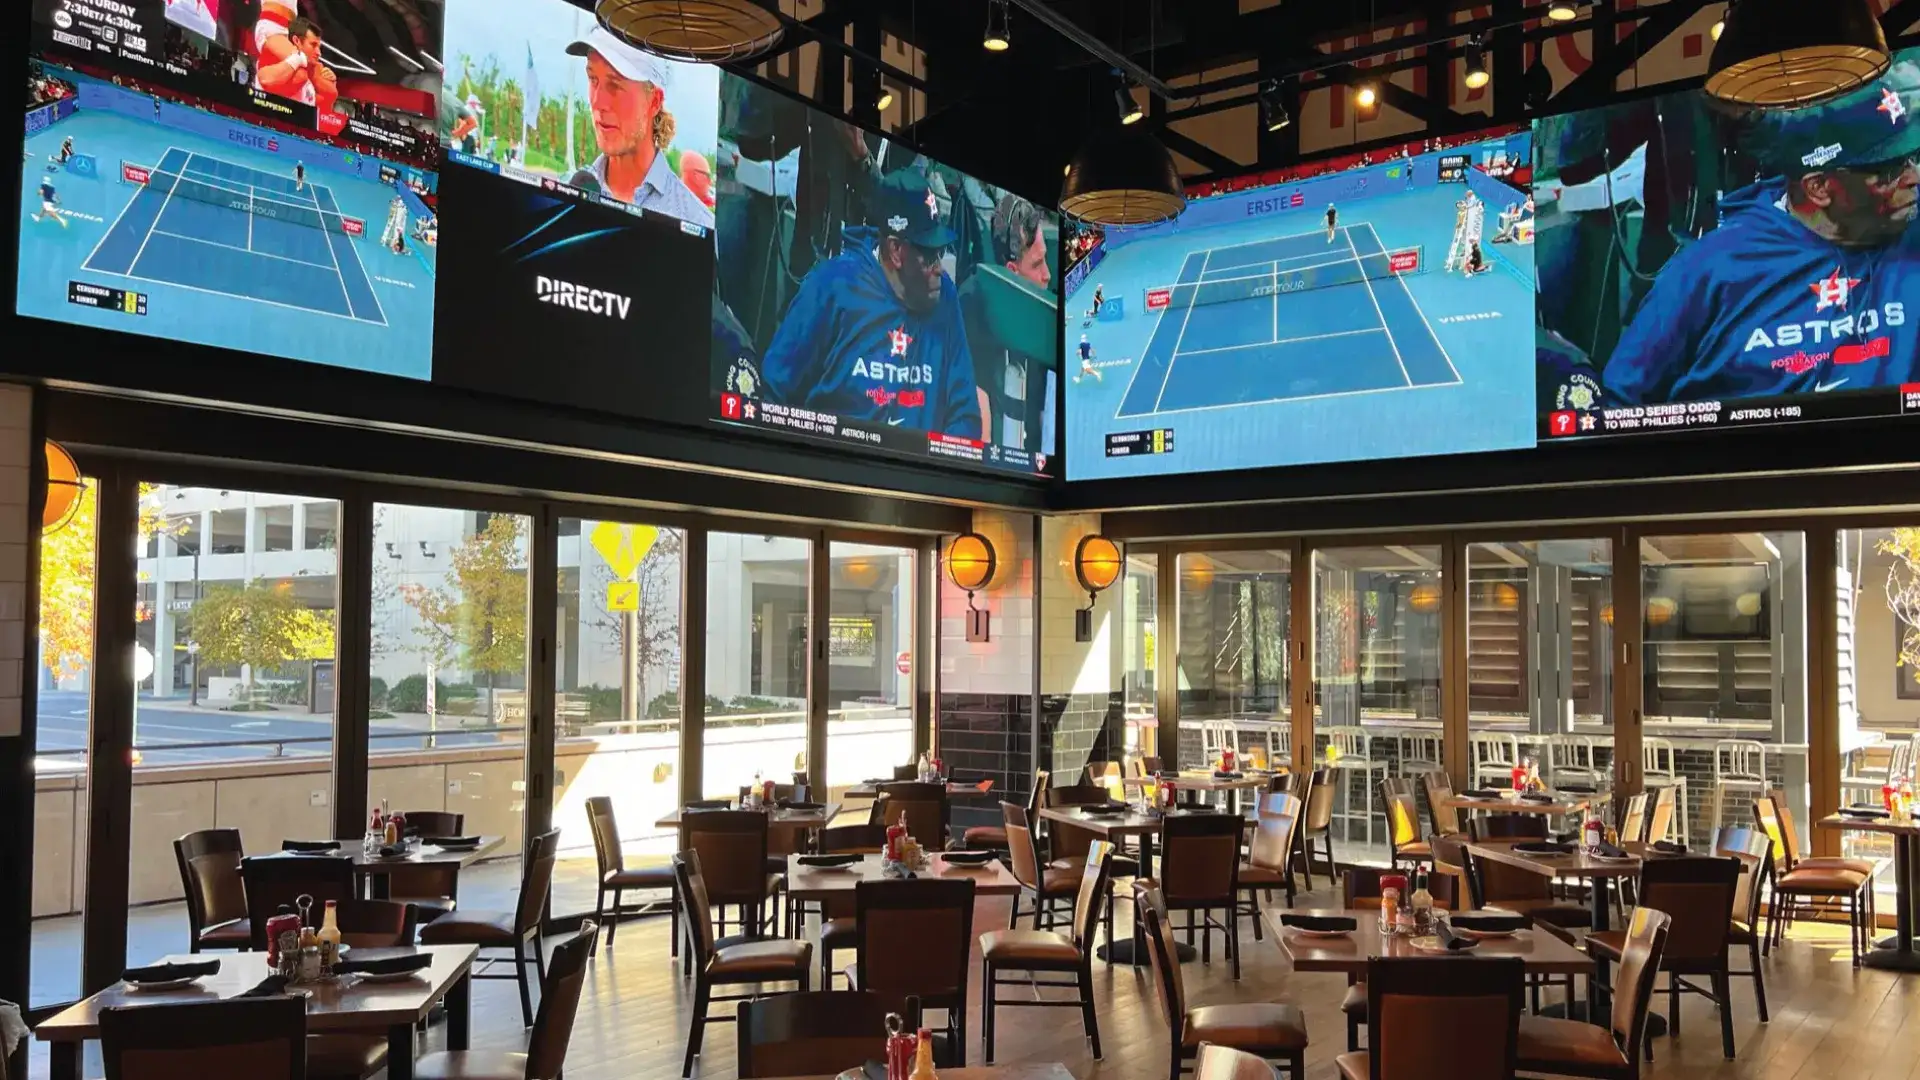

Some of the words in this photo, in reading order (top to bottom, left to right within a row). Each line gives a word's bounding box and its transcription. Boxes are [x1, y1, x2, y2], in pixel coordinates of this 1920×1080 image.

[122, 49, 154, 66] Panthers
[166, 62, 188, 76] Flyers
[228, 129, 265, 150] ERSTE
[1246, 195, 1289, 216] ERSTE
[536, 275, 631, 320] DIRECTV
[1276, 280, 1305, 294] TOUR
[1744, 302, 1905, 352] ASTROS
[726, 364, 736, 391] KING
[852, 357, 933, 384] ASTROS
[1556, 384, 1568, 409] KING
[1570, 374, 1602, 397] COUNTY
[761, 402, 789, 416] WORLD
[790, 407, 816, 421] SERIES
[817, 413, 837, 425] ODDS
[1604, 407, 1645, 420] WORLD
[1646, 403, 1686, 416] SERIES
[1688, 401, 1721, 413] ODDS
[1604, 420, 1618, 430] TO
[1620, 418, 1640, 428] WIN:
[1642, 416, 1684, 427] PHILLIES
[1686, 413, 1718, 425] (+160)
[1730, 409, 1772, 420] ASTROS
[1773, 406, 1802, 418] (-185)
[761, 413, 771, 422] TO
[787, 418, 814, 431] PHILLIES
[841, 427, 866, 440] ASTROS
